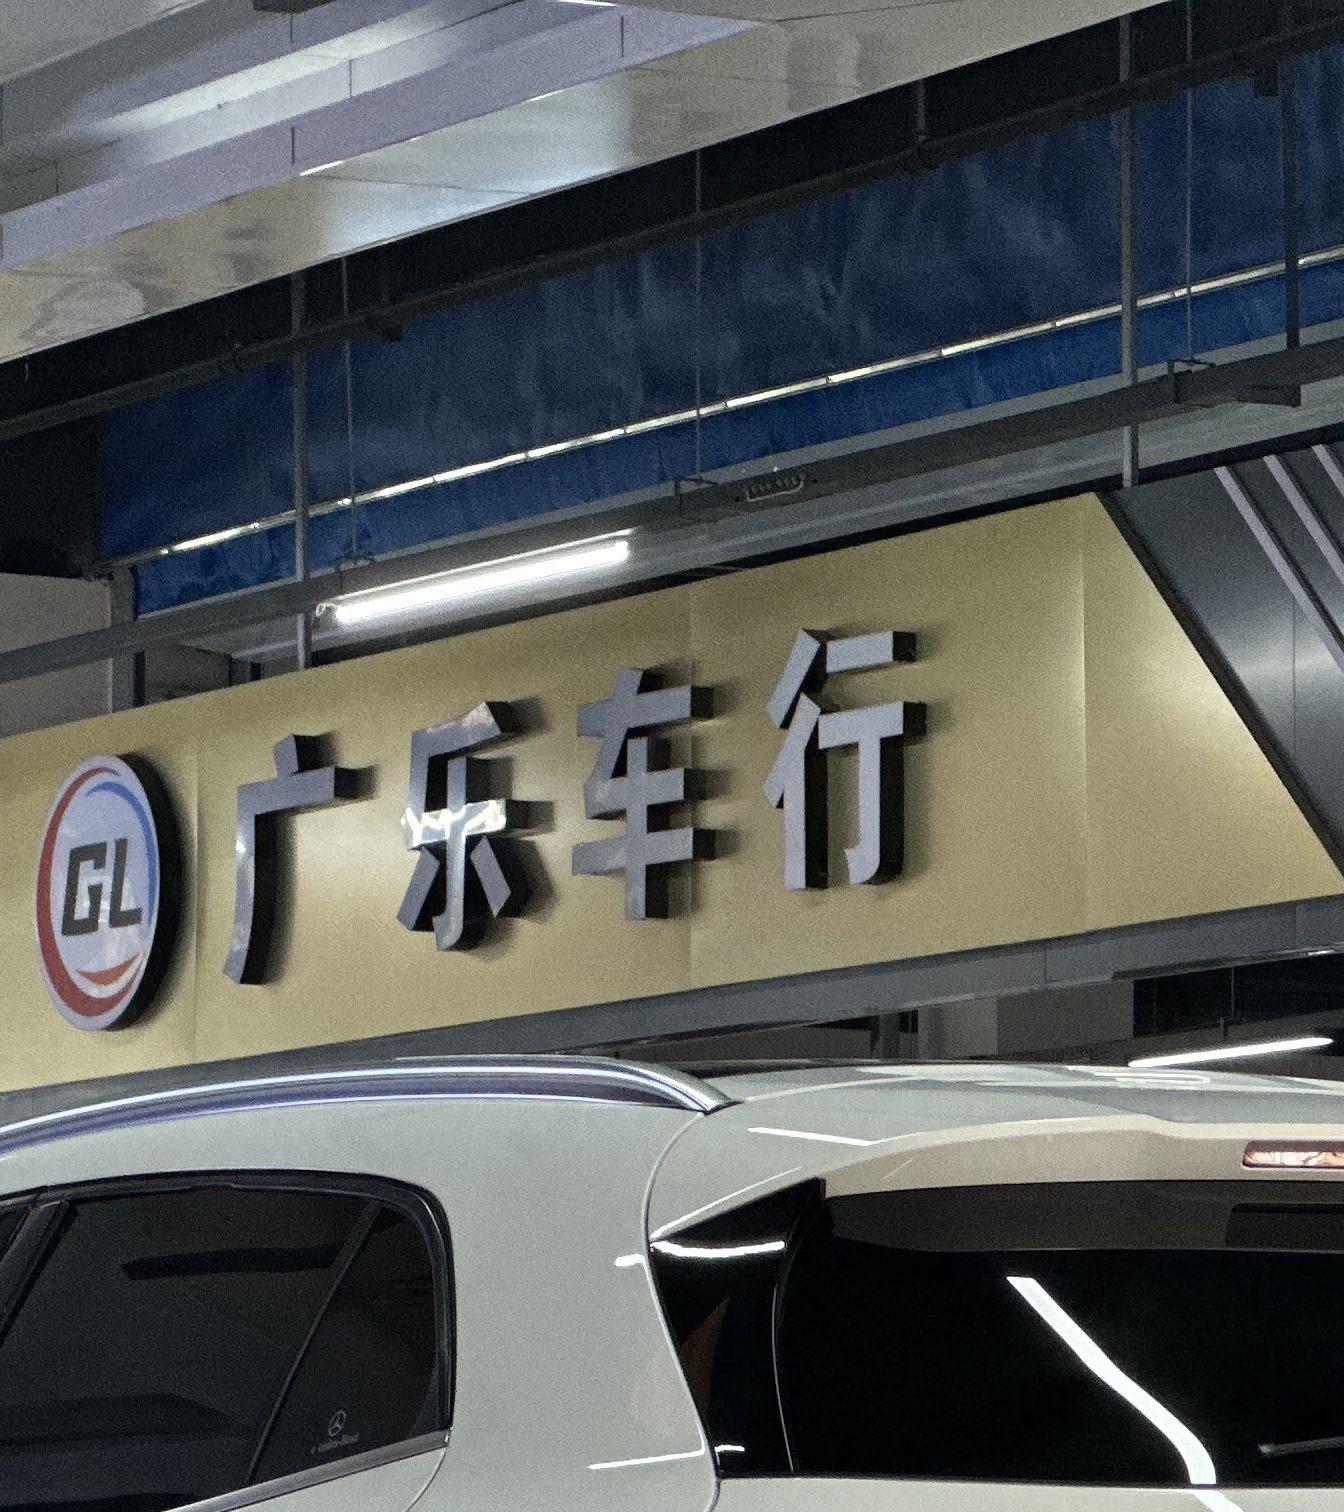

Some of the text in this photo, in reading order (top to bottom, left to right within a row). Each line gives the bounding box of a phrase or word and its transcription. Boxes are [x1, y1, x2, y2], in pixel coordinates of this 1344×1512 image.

[61, 838, 145, 938] GL
[222, 629, 928, 985] 广乐车行
